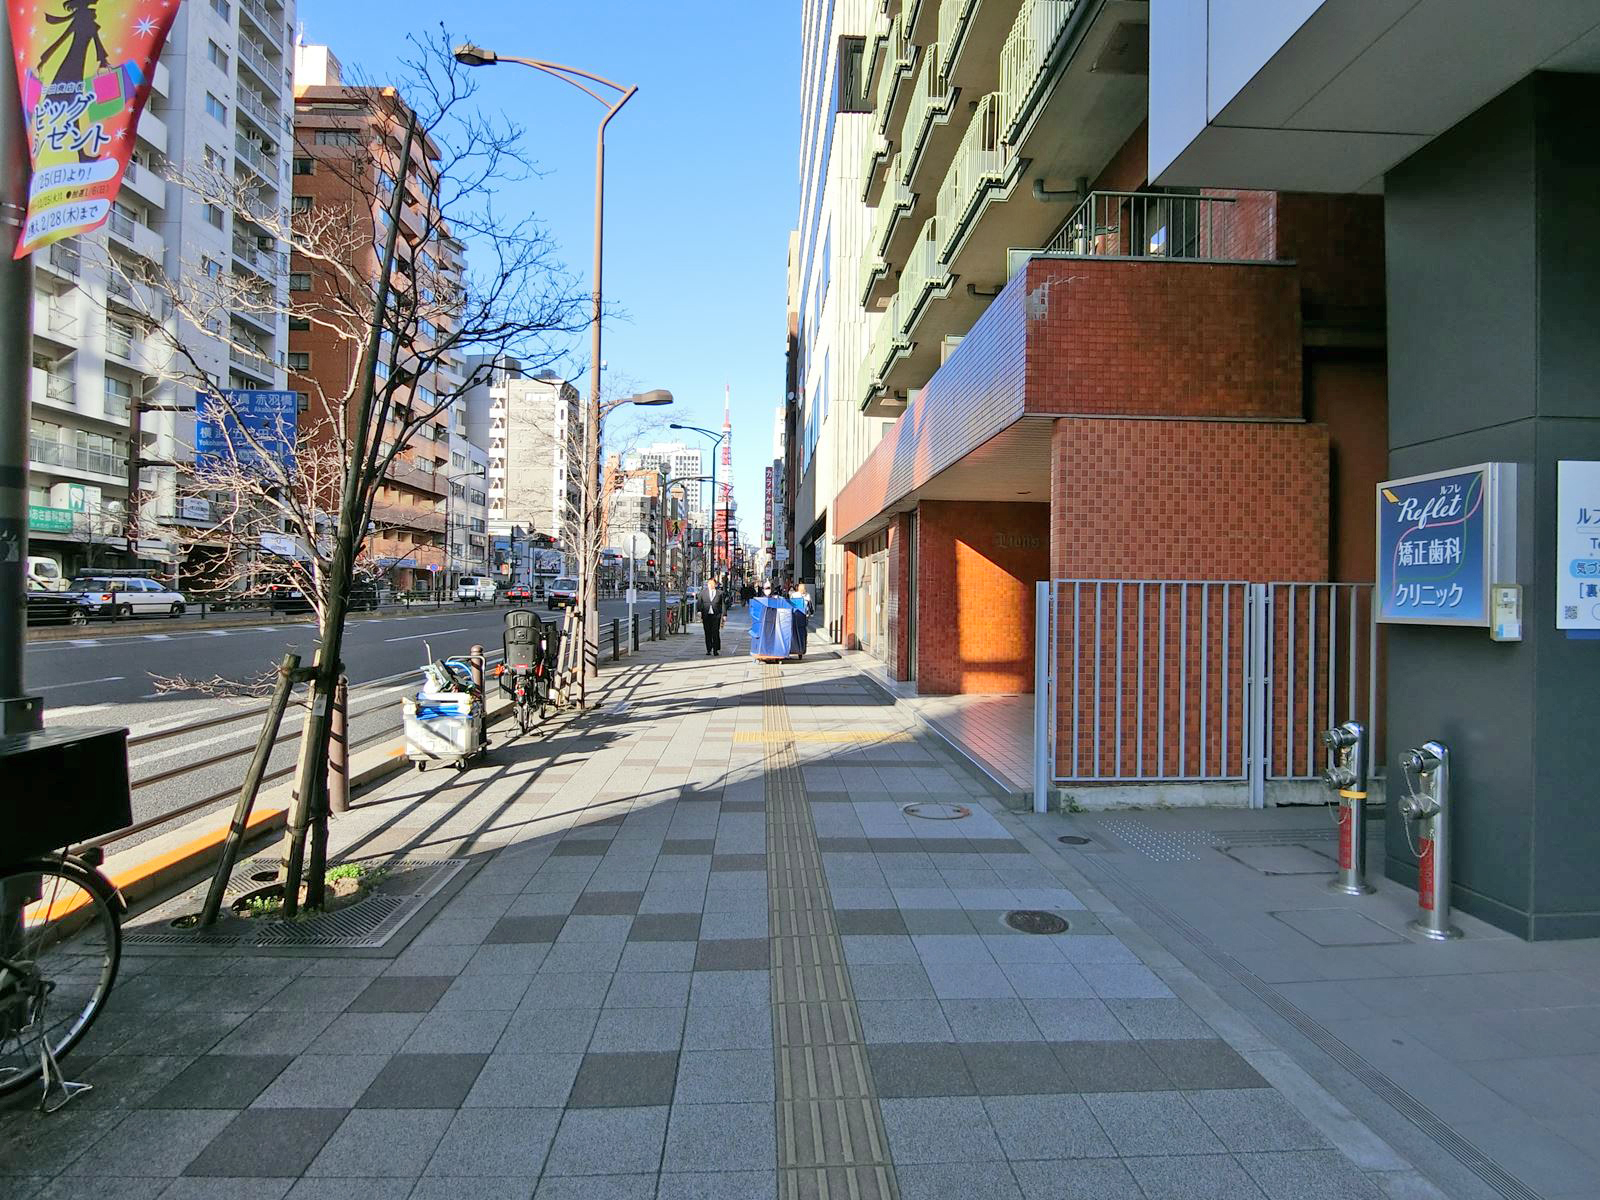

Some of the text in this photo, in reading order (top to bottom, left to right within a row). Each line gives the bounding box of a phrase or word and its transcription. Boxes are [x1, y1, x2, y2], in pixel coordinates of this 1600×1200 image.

[1440, 484, 1461, 496] ルフレ
[1398, 494, 1462, 529] Reflet
[1398, 537, 1462, 567] 矯正歯科
[1396, 583, 1464, 608] クリニック
